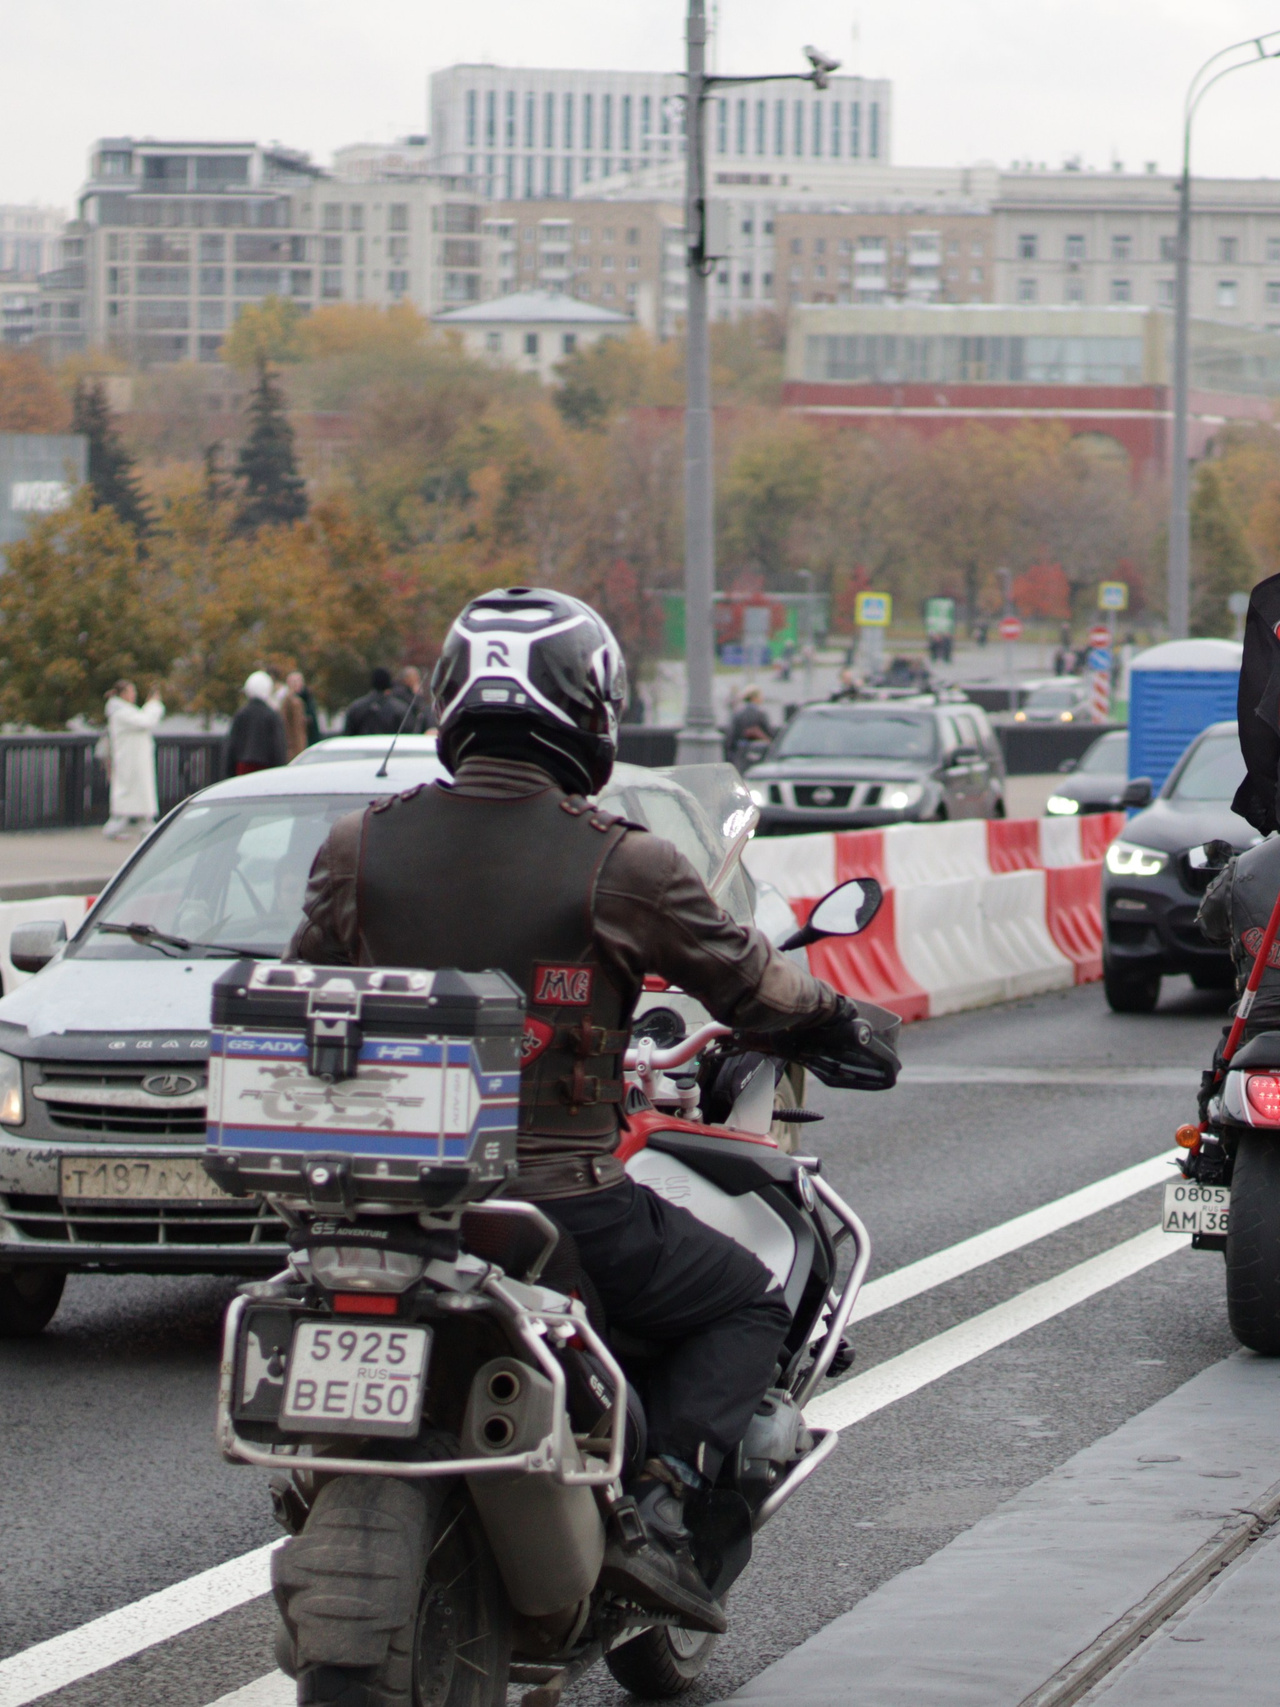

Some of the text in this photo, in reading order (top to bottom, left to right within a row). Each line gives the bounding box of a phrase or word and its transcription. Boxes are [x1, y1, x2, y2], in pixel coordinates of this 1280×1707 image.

[1174, 1186, 1225, 1203] 0805
[310, 1221, 389, 1239] GS ADVENTURE
[1206, 1212, 1230, 1231] 38
[310, 1329, 408, 1365] 5925
[356, 1368, 388, 1380] RUS
[361, 1383, 409, 1416] 50
